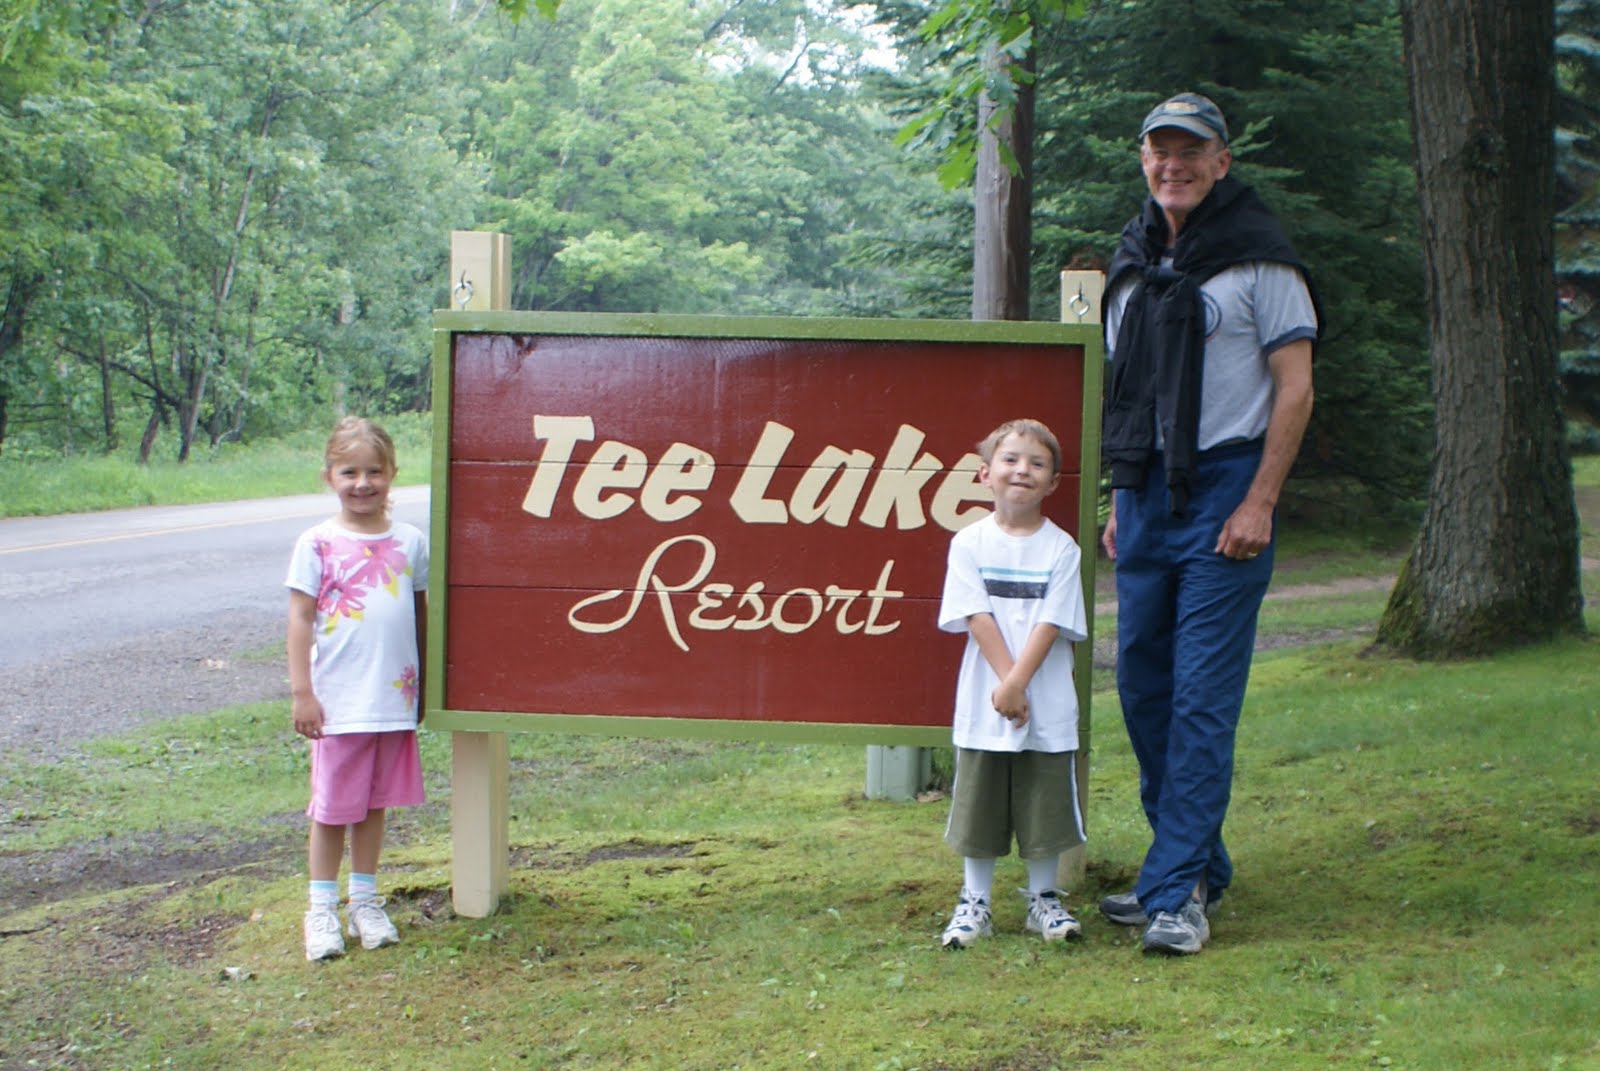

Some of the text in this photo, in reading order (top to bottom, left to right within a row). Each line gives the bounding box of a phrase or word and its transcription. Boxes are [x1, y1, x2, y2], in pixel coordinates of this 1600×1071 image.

[521, 414, 995, 532] Tee Lake
[567, 534, 904, 652] Resort
